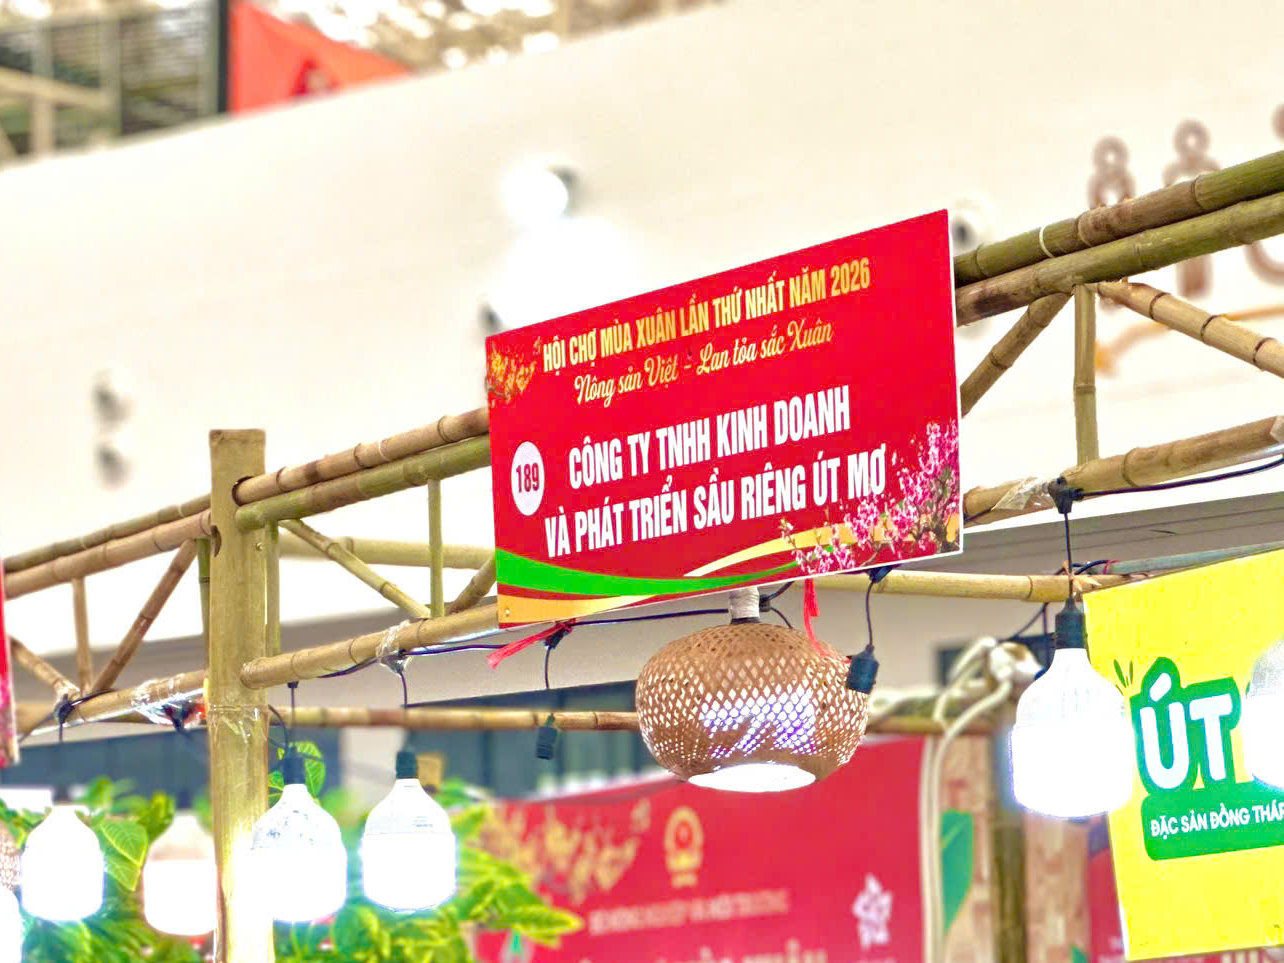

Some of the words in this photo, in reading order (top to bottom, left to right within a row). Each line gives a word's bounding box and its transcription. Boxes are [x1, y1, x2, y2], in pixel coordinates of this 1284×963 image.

[543, 335, 566, 376] HỘI
[569, 327, 597, 367] CHỢ
[600, 318, 633, 358] MÙA
[636, 307, 676, 349] XUÂN
[679, 292, 710, 338] LẦN
[712, 286, 743, 329] THỨ
[745, 270, 786, 320] NHẤT
[789, 266, 827, 308] NĂM
[830, 256, 871, 297] 2026
[574, 374, 617, 408] Nông
[618, 365, 644, 394] sản
[644, 353, 680, 389] Việt
[696, 342, 731, 376] Lan
[732, 337, 759, 366] tỏa
[760, 324, 787, 359] sắc
[787, 318, 835, 352] Xuân
[516, 462, 539, 493] 189
[569, 436, 623, 489] CÔNG
[627, 431, 651, 477] TY
[656, 417, 711, 471] TNHH
[716, 404, 768, 458] KINH
[774, 384, 851, 445] DOANH
[545, 506, 571, 558] VÀ
[575, 496, 624, 552] PHÁT
[629, 475, 688, 542] TRIỂN
[693, 467, 735, 530] SẦU
[741, 462, 806, 520] RIÊNG
[813, 450, 841, 506] ÚT
[1139, 672, 1233, 789] ÚT
[1150, 815, 1179, 840] ĐẶC
[1181, 809, 1208, 832] SẢN
[1209, 802, 1250, 829] ĐỒNG
